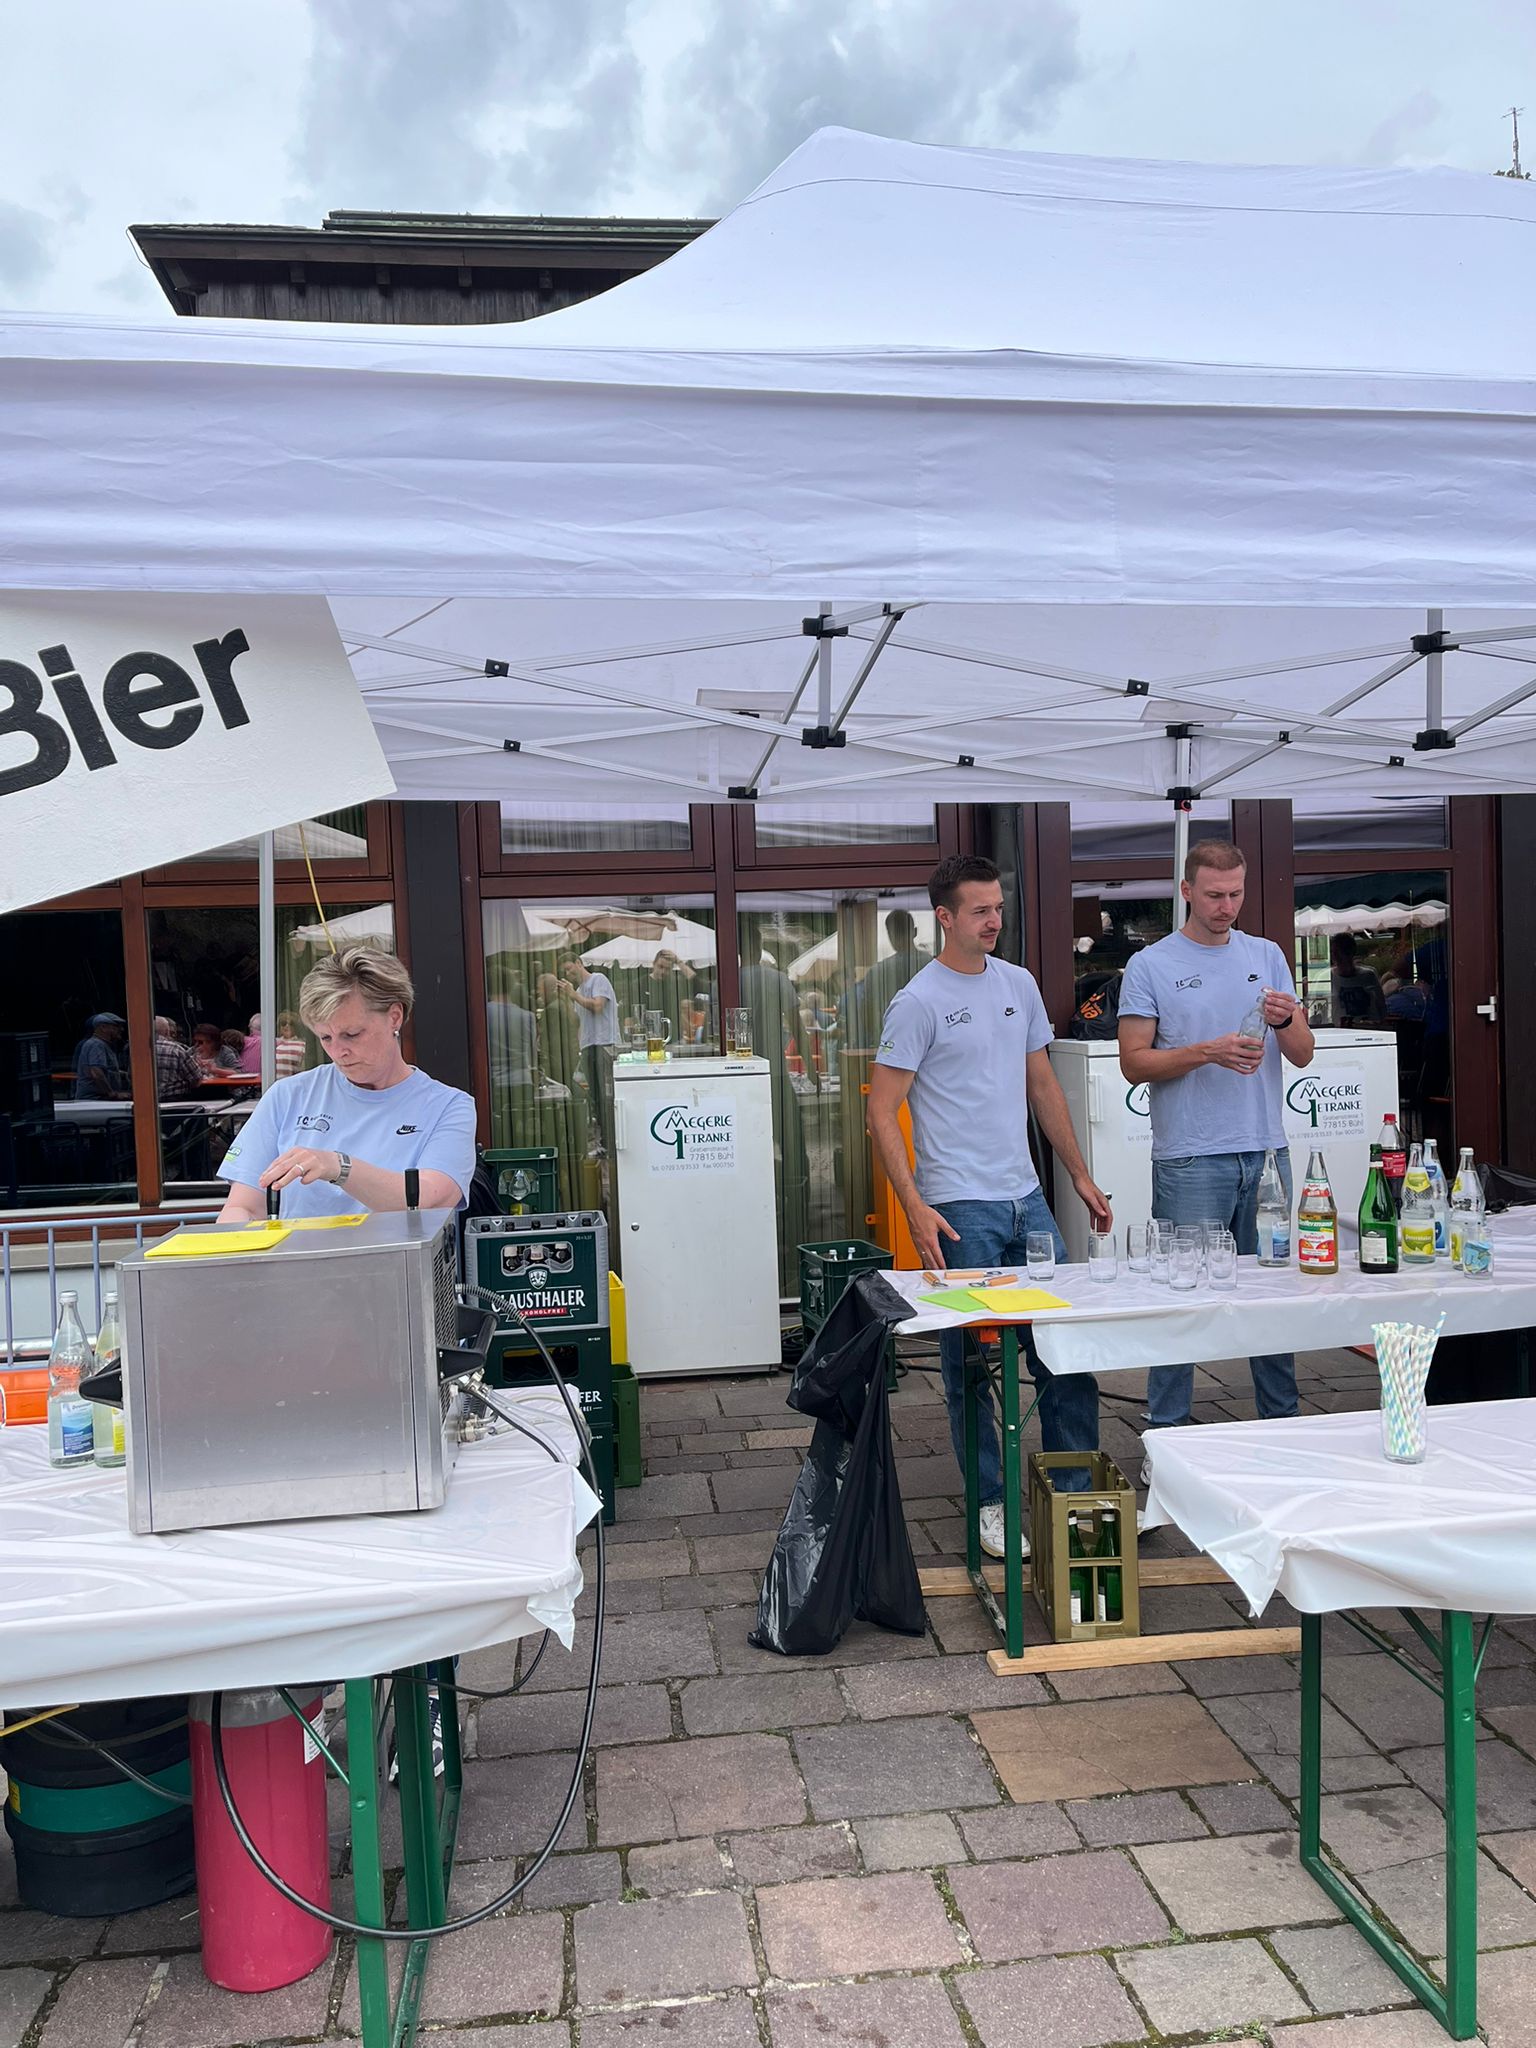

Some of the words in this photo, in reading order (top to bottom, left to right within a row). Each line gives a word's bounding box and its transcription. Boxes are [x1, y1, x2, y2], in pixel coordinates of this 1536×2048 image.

[0, 627, 250, 797] Bier
[1299, 1080, 1363, 1100] MEGERLE
[665, 1110, 734, 1129] MEGERLE
[1323, 1121, 1347, 1129] 77815
[690, 1153, 716, 1162] 77815
[491, 1289, 586, 1313] CAUSTHALER
